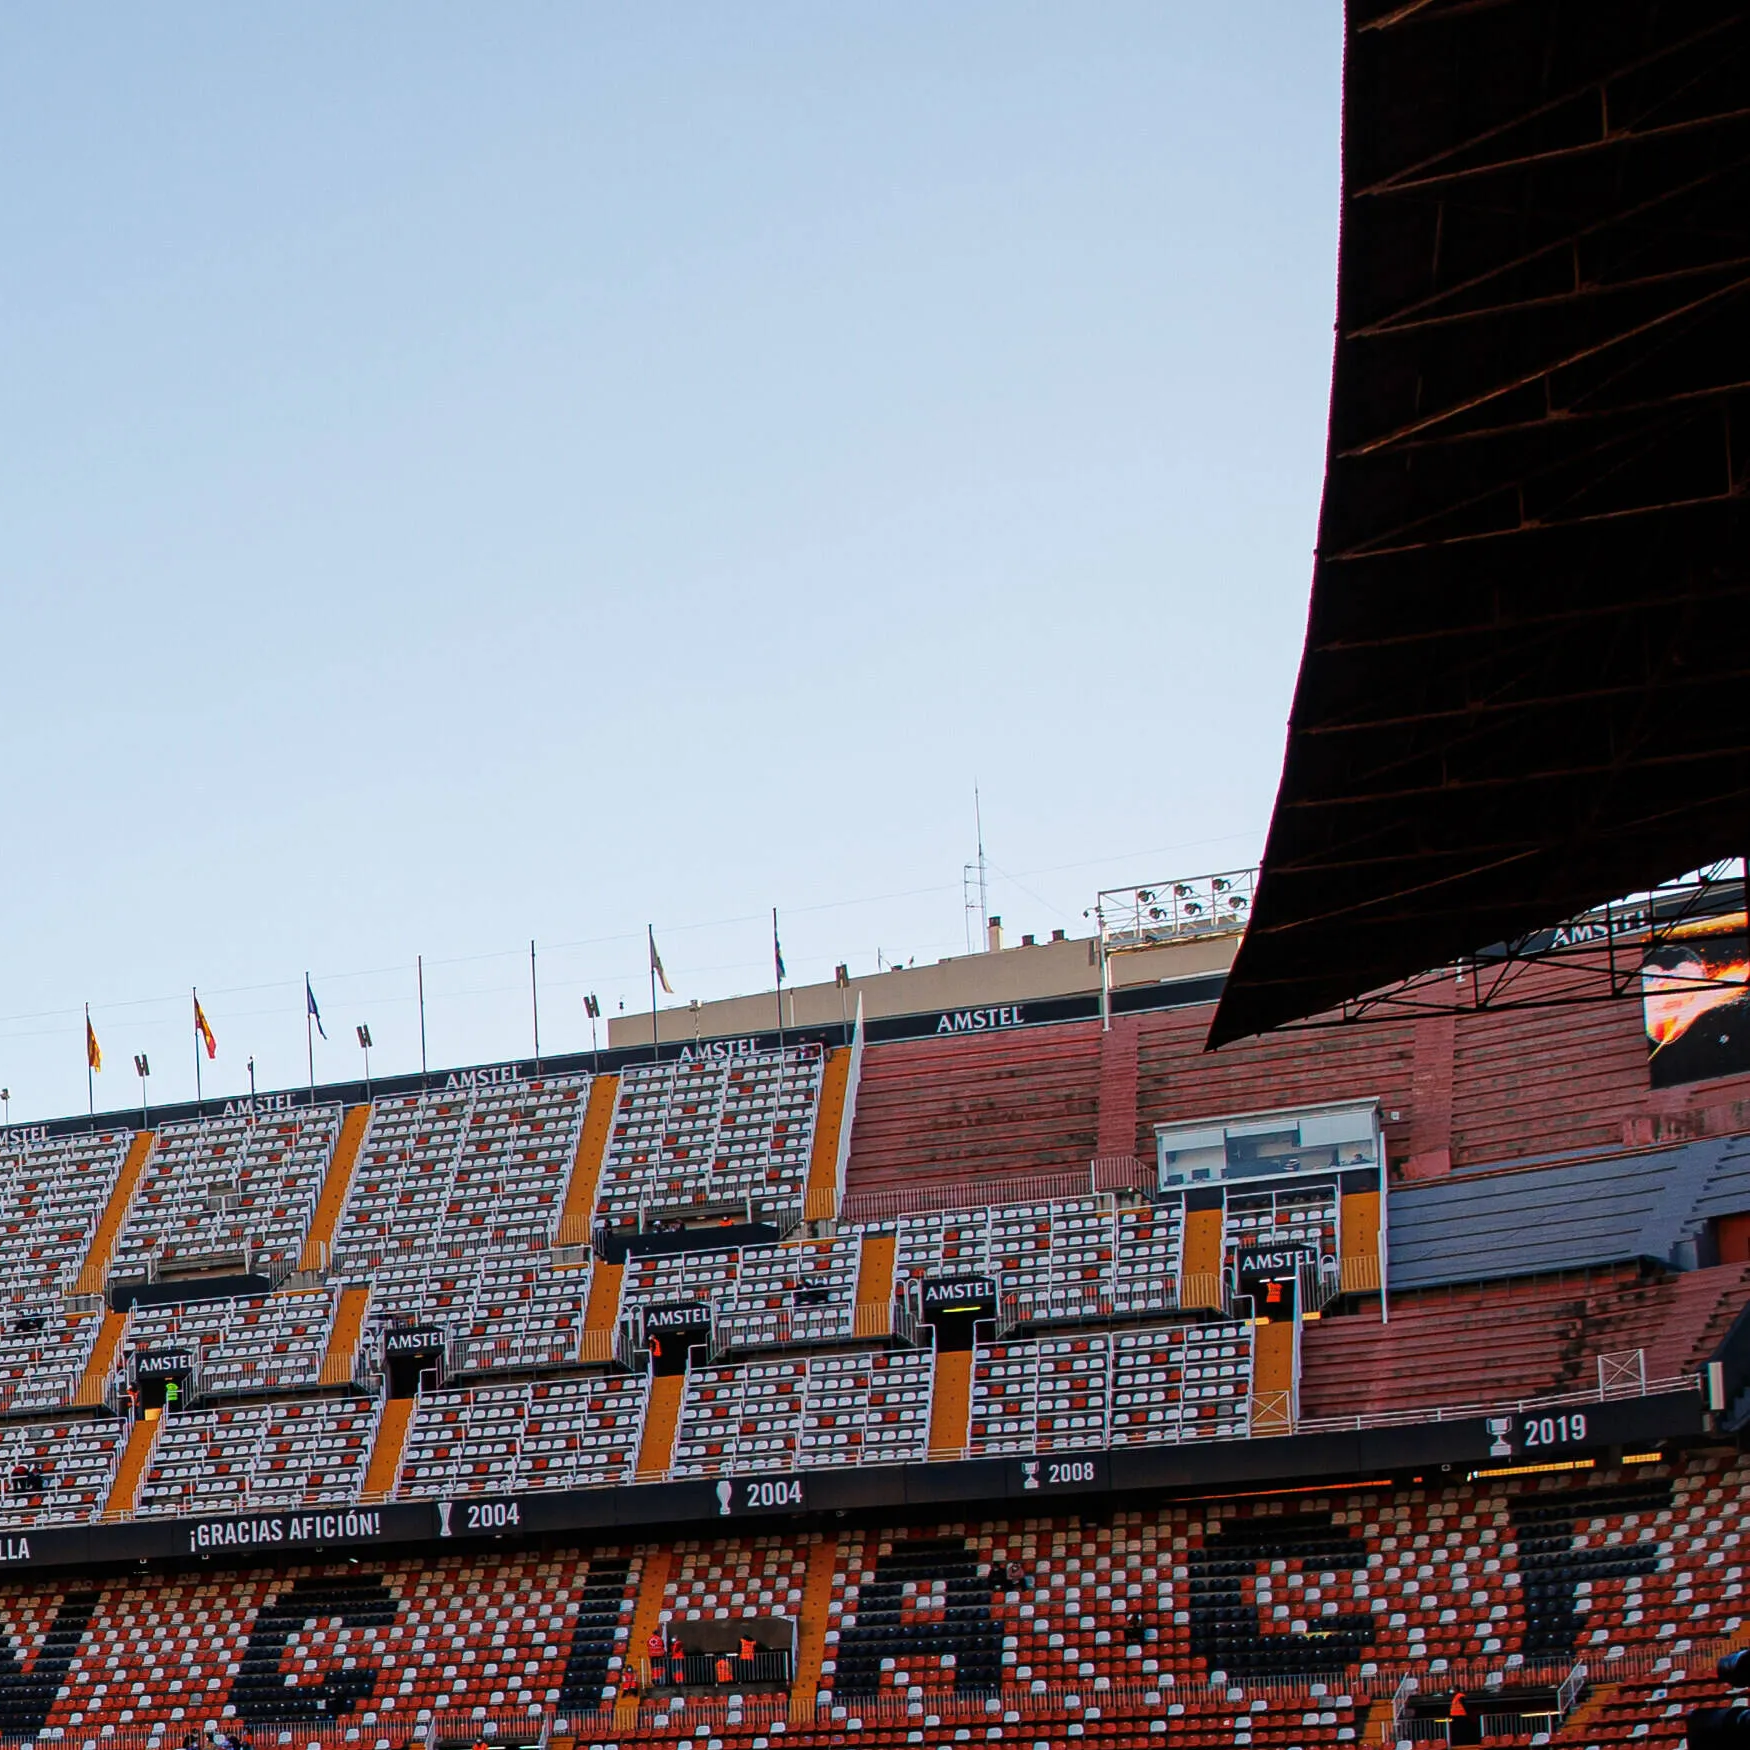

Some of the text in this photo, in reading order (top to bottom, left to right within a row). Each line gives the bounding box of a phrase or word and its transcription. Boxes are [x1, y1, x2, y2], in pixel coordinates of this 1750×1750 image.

[936, 1007, 1021, 1034] AMSTEL
[679, 1040, 759, 1063] AMSTEL
[444, 1066, 520, 1091] AMSTEL
[222, 1095, 294, 1118] AMSTEL
[1242, 1251, 1316, 1273] AMSTEL
[925, 1282, 995, 1302] AMSTEL
[646, 1308, 711, 1327] AMSTEL
[387, 1331, 446, 1350] AMSTEL
[1524, 1413, 1587, 1446] 2019
[1048, 1461, 1094, 1484] 2008
[747, 1478, 802, 1508] 2004
[467, 1502, 520, 1528] 2004
[189, 1510, 381, 1553] ¡GRACIAS AFICIÓN!
